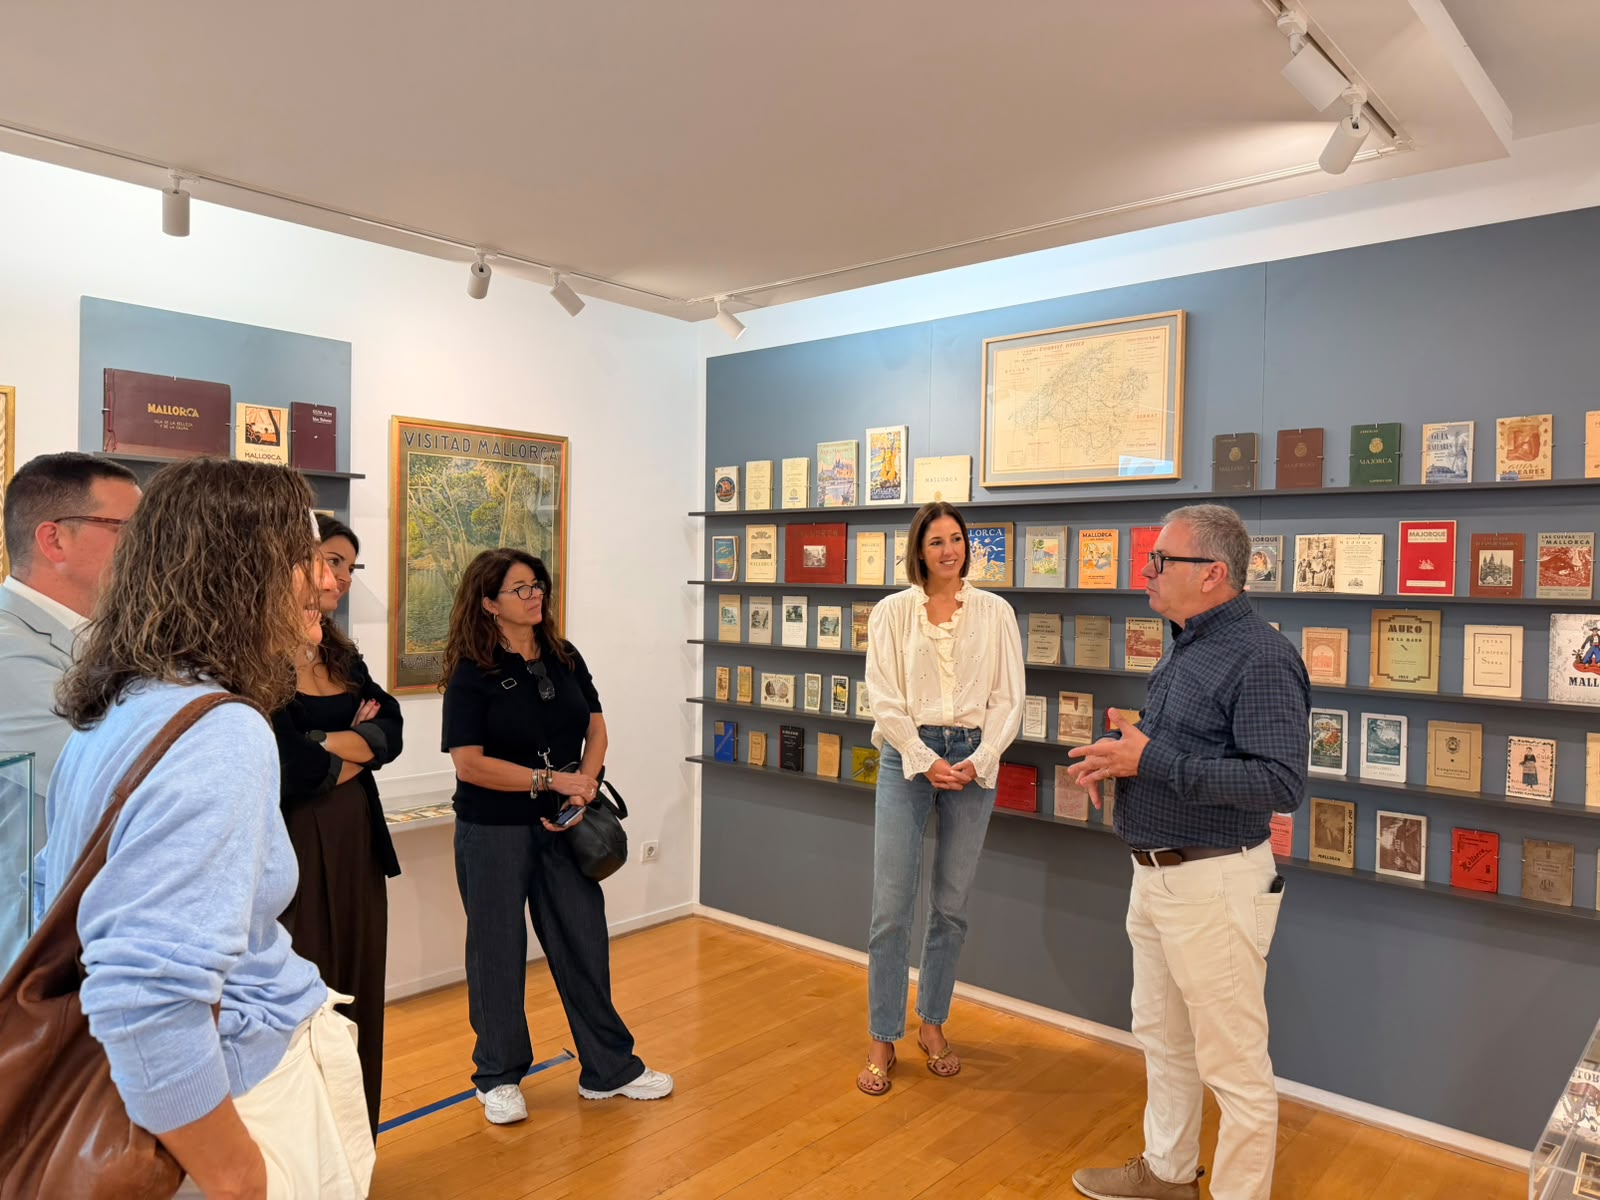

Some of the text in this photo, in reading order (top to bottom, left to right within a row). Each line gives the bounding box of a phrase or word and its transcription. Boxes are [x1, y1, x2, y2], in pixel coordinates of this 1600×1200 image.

[147, 402, 200, 418] MALLORCA
[403, 431, 559, 461] VISITAD MALLORCA
[244, 451, 282, 461] MALLORCA
[967, 528, 1003, 538] LORCA
[1388, 624, 1423, 634] MURO
[1568, 676, 1600, 688] MALL
